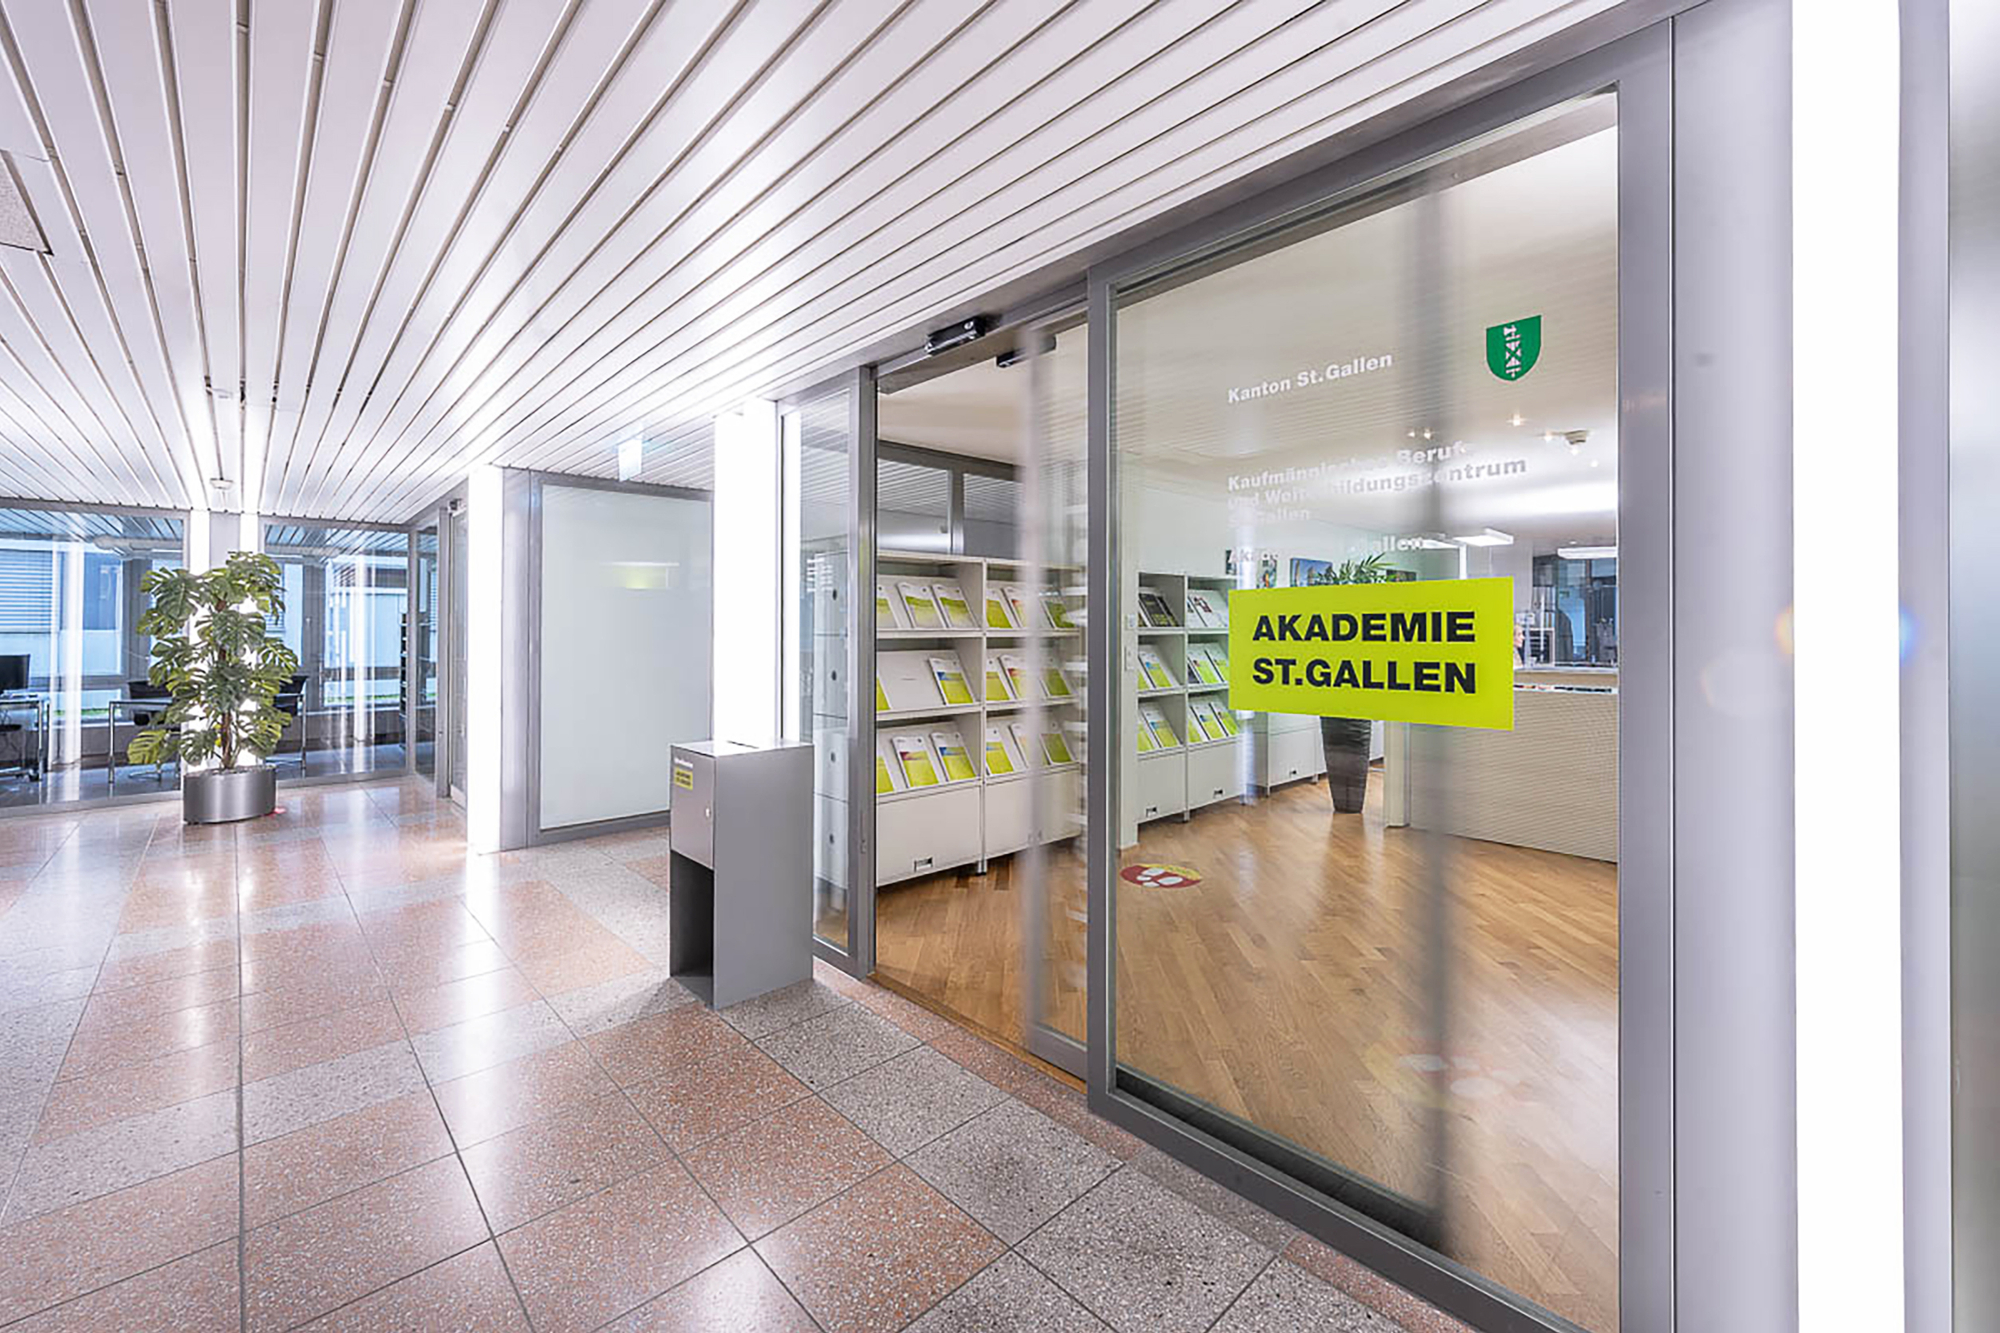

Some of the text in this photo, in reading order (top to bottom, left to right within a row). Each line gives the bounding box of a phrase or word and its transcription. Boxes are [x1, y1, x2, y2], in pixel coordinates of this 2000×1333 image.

[1227, 353, 1393, 404] Kanton St.Gallen
[1252, 610, 1477, 643] AKADEMIE
[1252, 658, 1477, 694] ST.GALLEN
